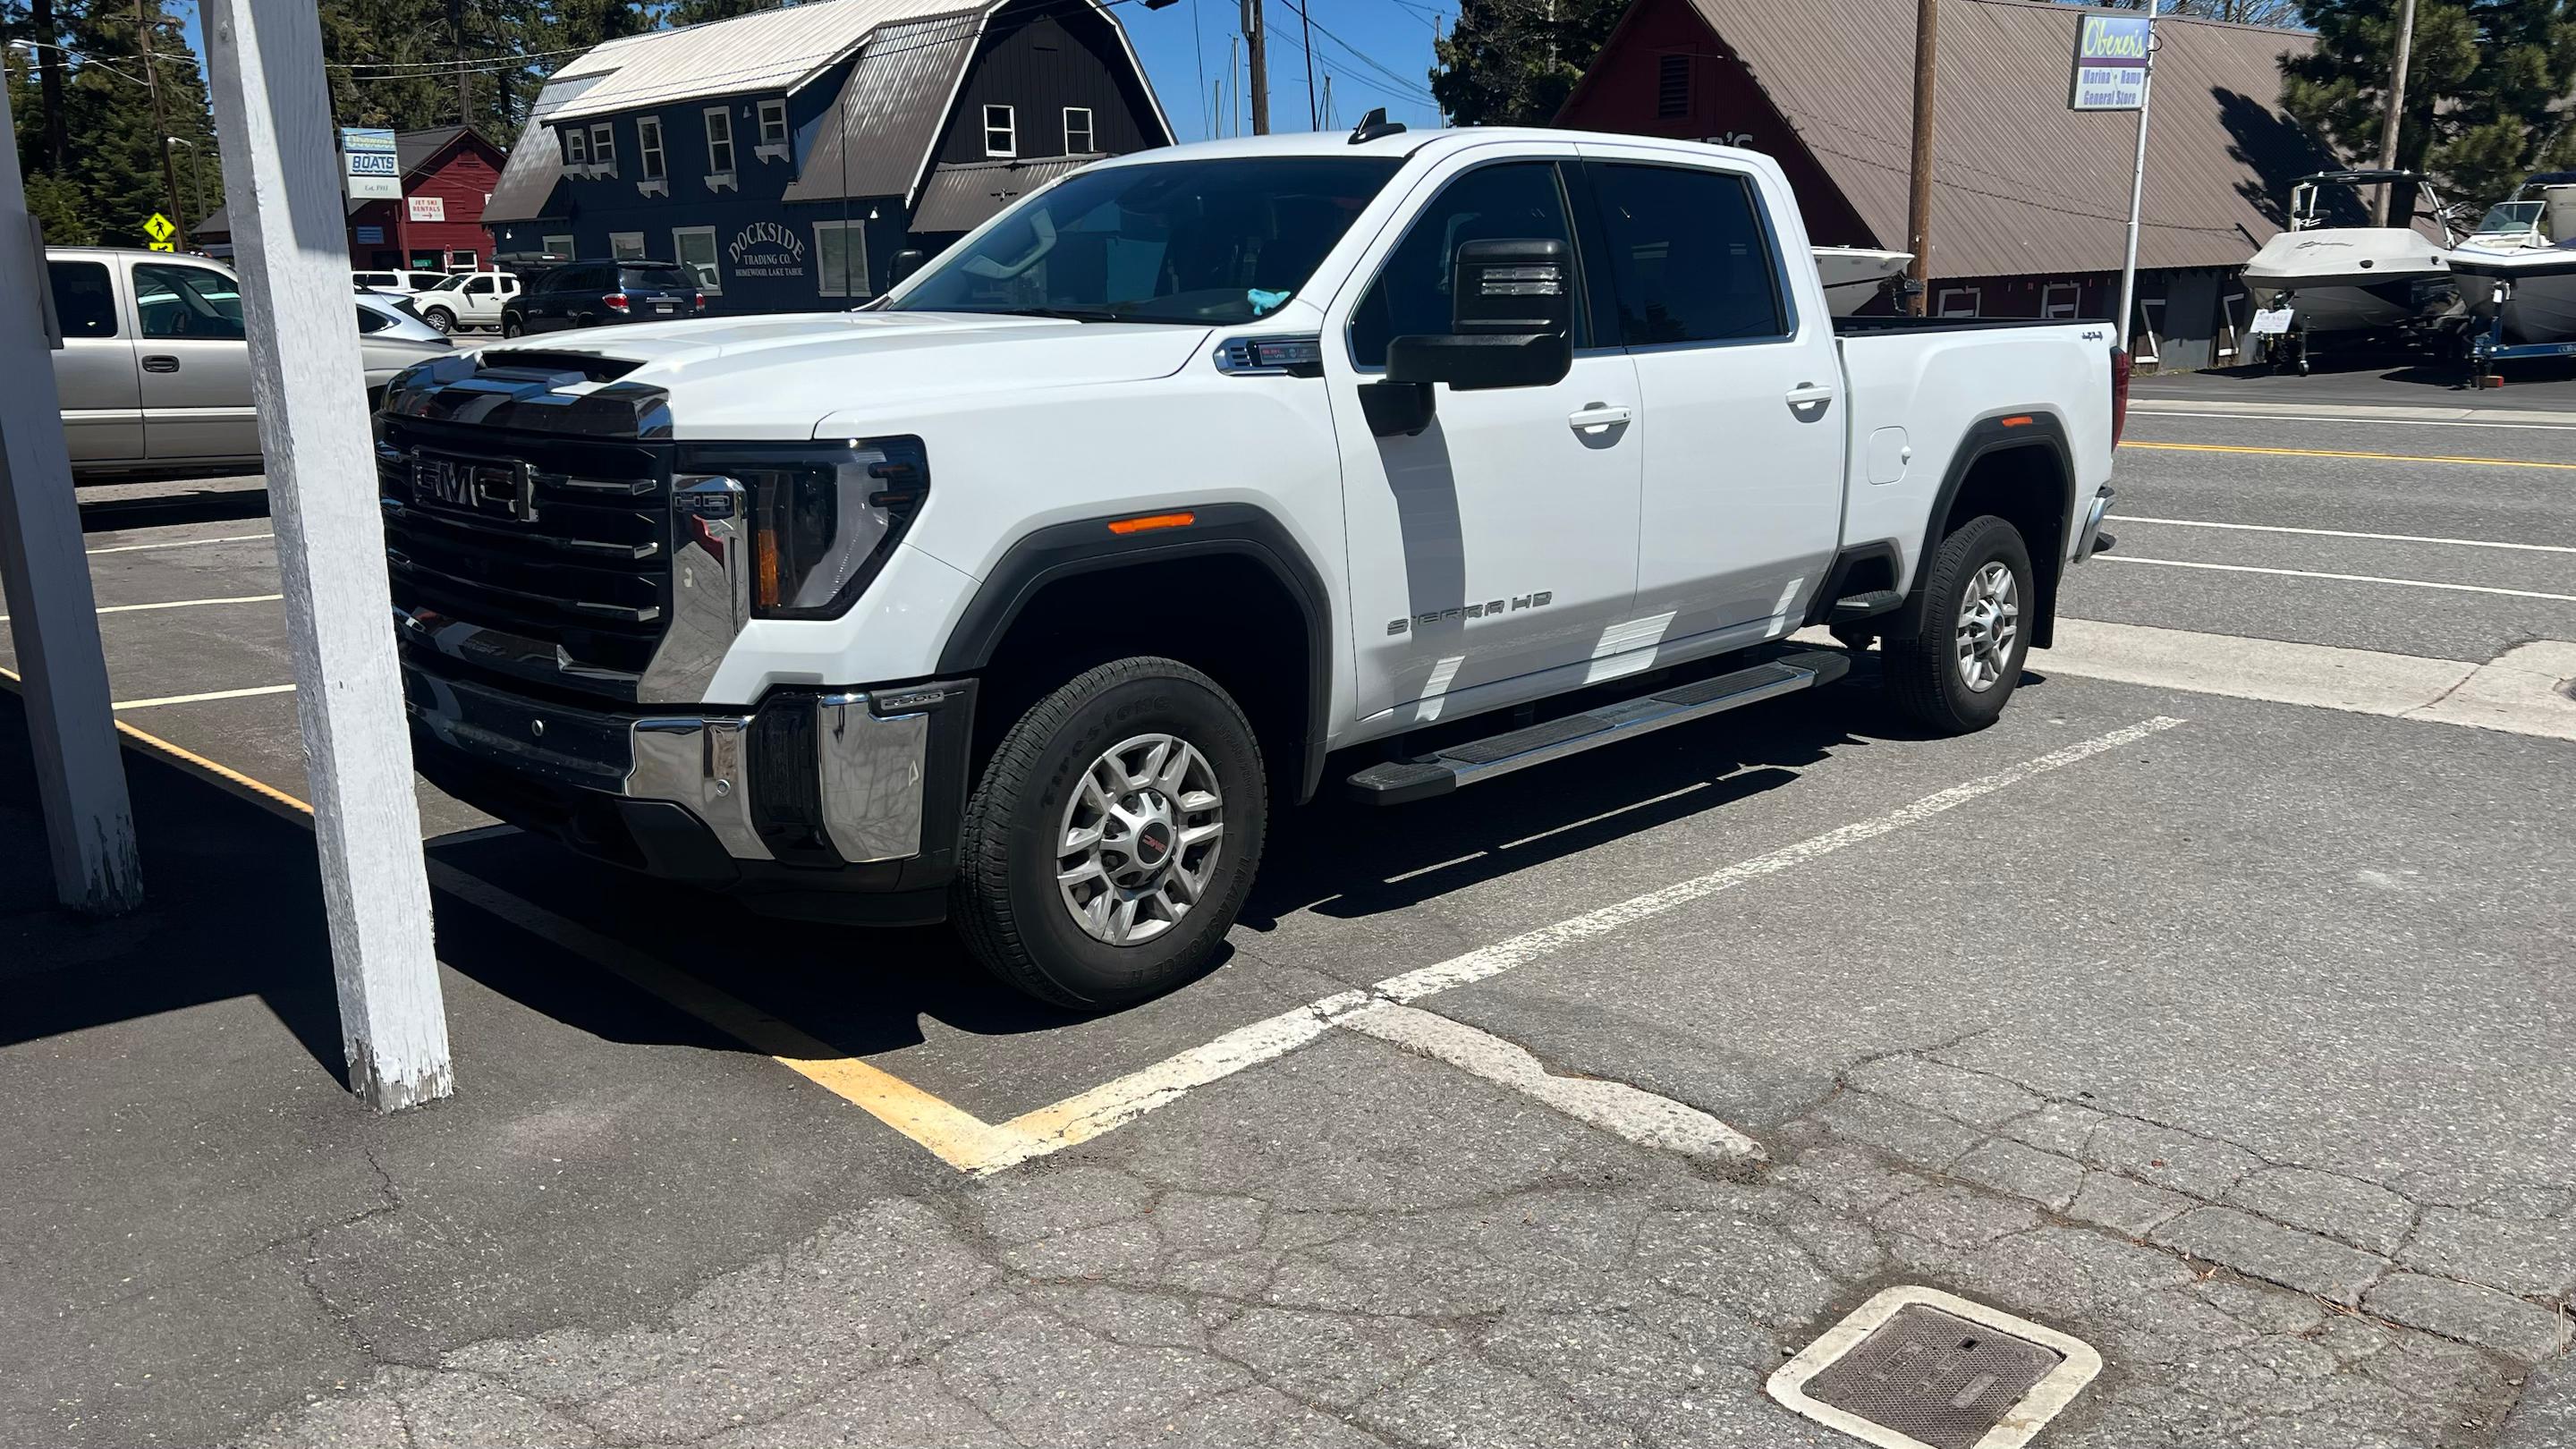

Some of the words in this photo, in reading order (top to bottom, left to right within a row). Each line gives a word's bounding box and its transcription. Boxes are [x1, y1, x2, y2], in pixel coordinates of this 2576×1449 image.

[2083, 18, 2146, 57] Obexer's
[2082, 69, 2111, 84] Marina
[2121, 70, 2141, 85] Ramp
[2083, 90, 2114, 106] General
[2116, 90, 2137, 106] Store
[352, 156, 394, 169] BOATS
[728, 222, 805, 264] DOCKSIDE
[743, 254, 777, 265] TRADING
[779, 254, 792, 265] CO.
[769, 268, 784, 276] LAKE
[412, 459, 517, 514] GMC
[1512, 591, 1552, 611] HD
